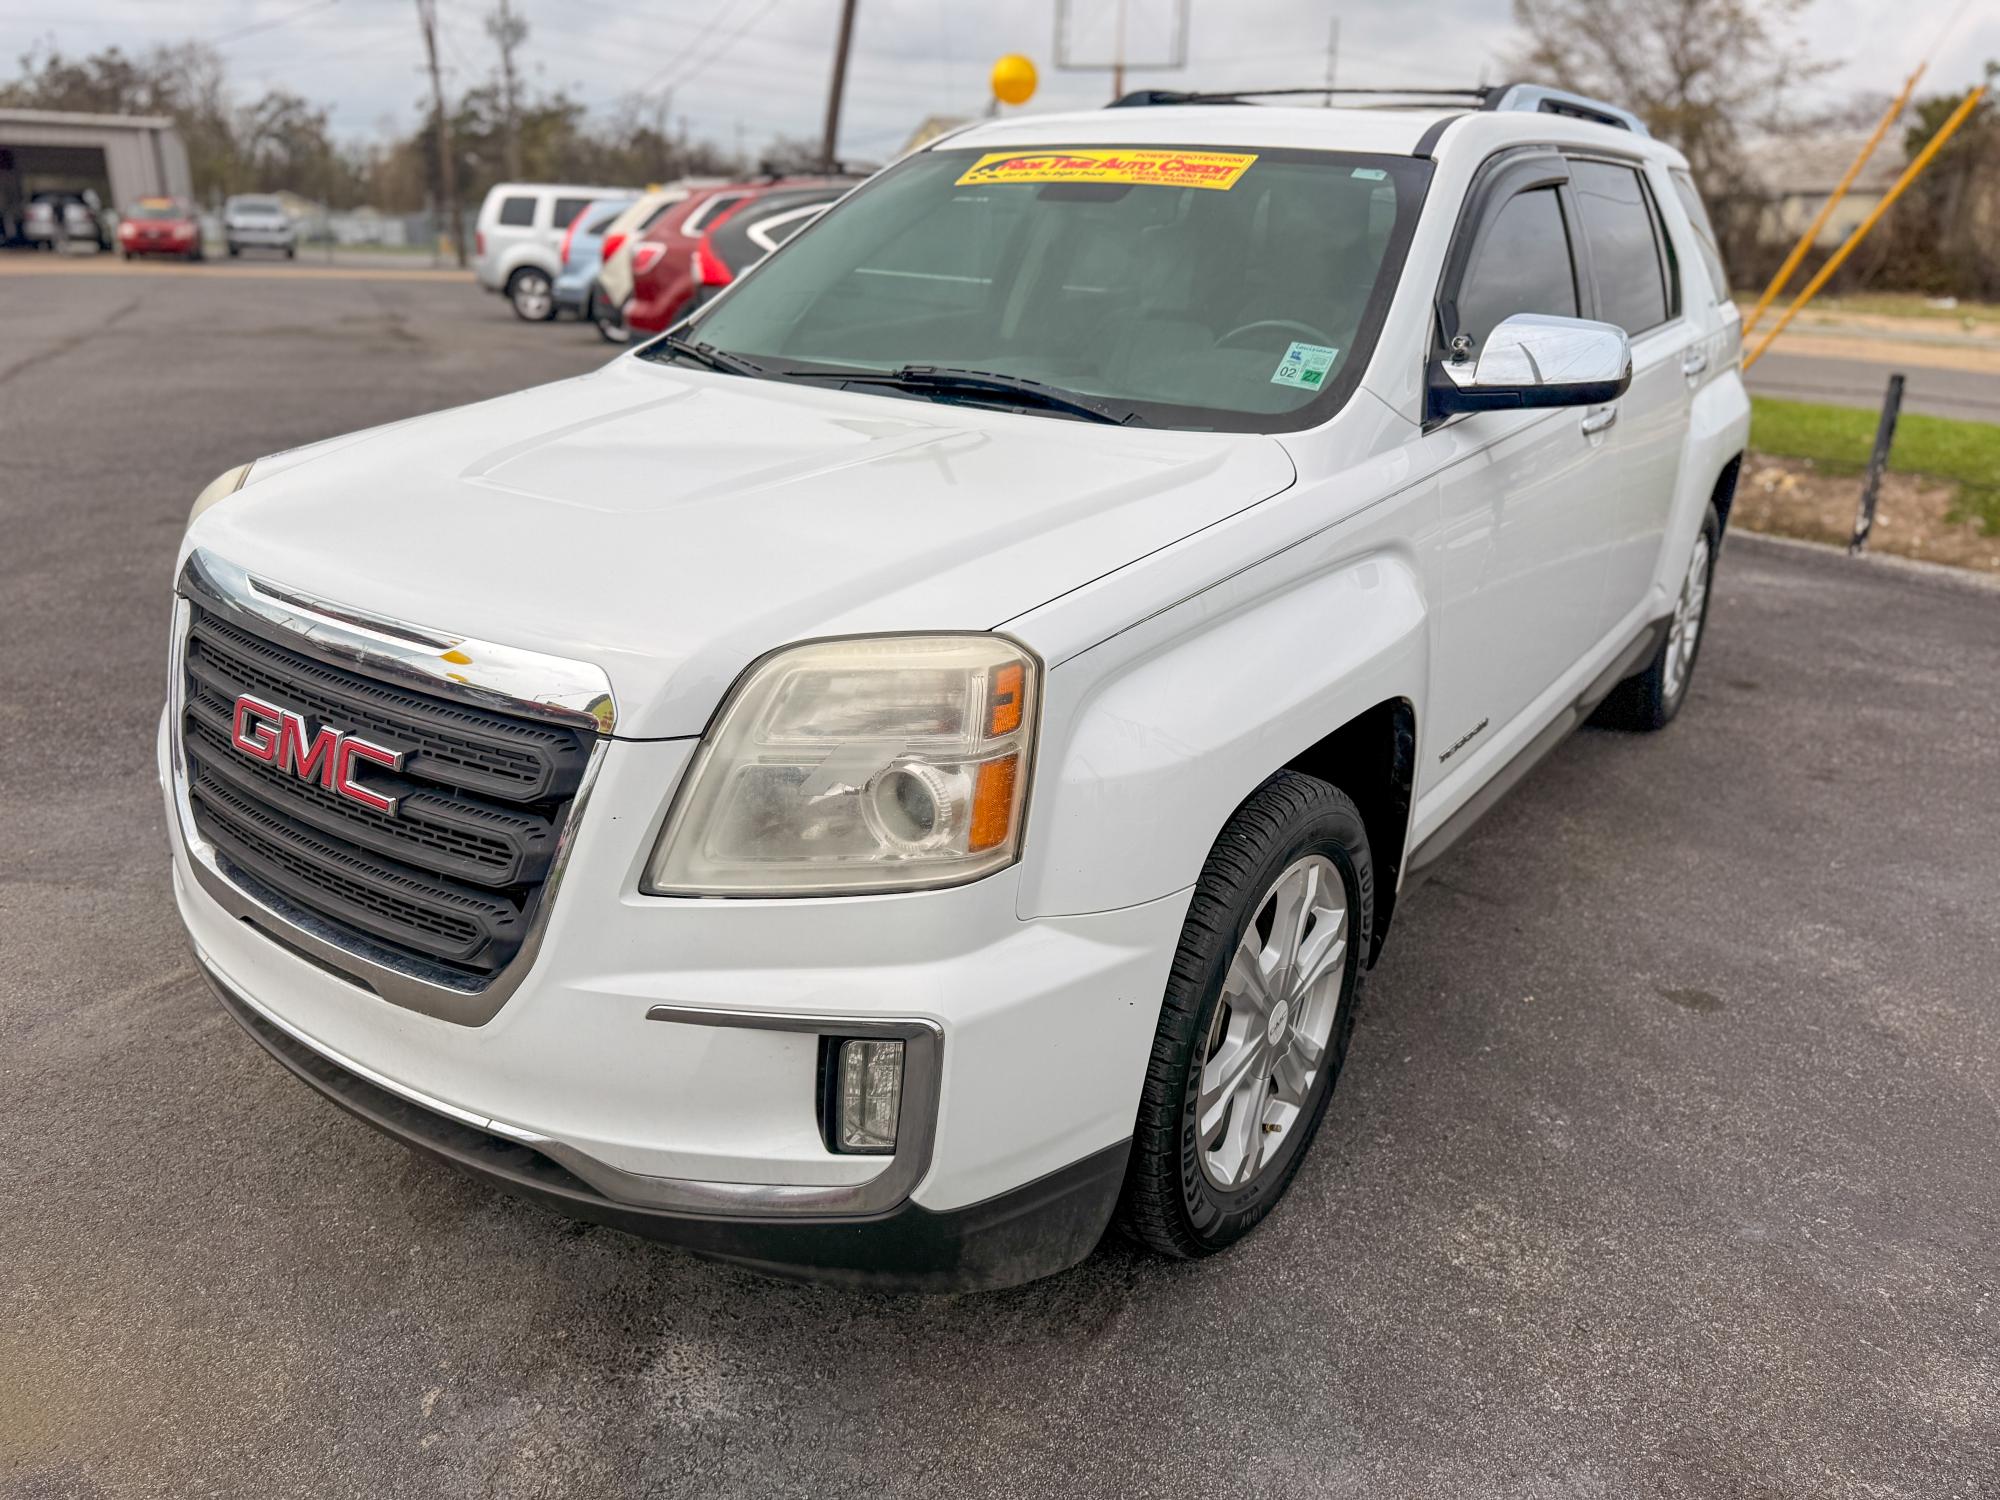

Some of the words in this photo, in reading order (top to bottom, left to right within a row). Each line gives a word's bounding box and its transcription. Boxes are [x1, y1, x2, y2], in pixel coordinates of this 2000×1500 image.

[1096, 157, 1156, 170] AUTO
[1158, 159, 1240, 176] CREDIT
[1280, 367, 1297, 378] 02
[1302, 370, 1321, 382] 27
[232, 694, 403, 818] GMC
